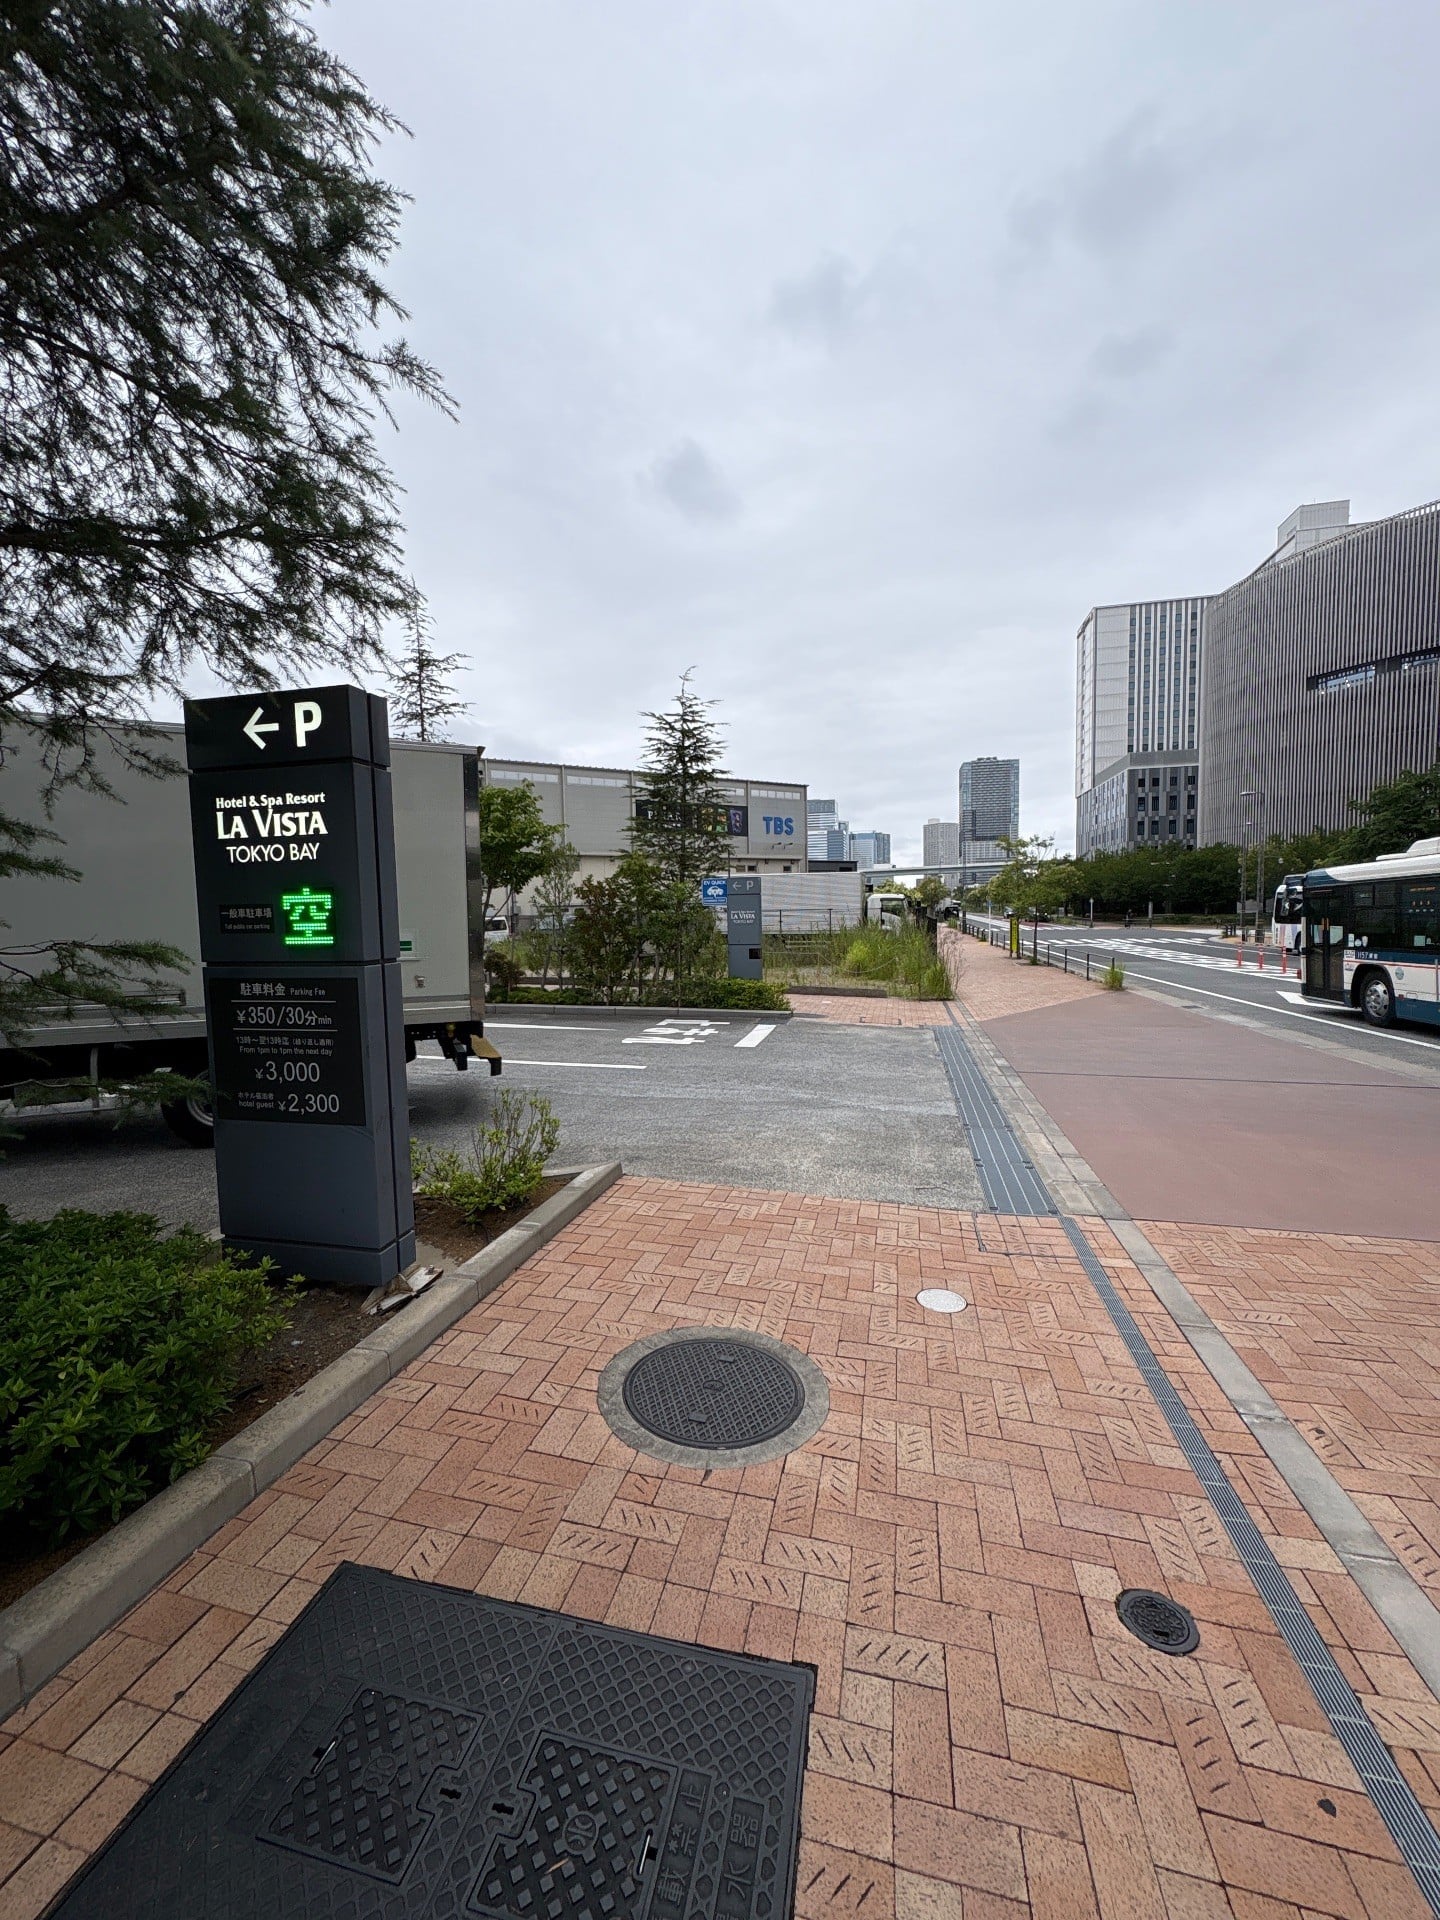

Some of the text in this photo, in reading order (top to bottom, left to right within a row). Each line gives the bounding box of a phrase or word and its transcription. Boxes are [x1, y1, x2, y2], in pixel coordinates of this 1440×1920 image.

[293, 701, 322, 748] P
[216, 792, 326, 809] Hotel & Spa Resort
[216, 808, 328, 840] LA VISTA
[763, 815, 794, 836] TBS
[226, 842, 320, 864] TOKYO BAY
[746, 880, 754, 891] P
[282, 887, 334, 945] 空
[240, 982, 326, 997] 駐車料金 Parking Fee
[621, 1018, 731, 1045] 止まれ
[239, 1046, 255, 1054] From
[280, 1048, 293, 1056] 1pm
[320, 1048, 333, 1057] day
[254, 1060, 320, 1084] ¥3,000
[238, 1100, 274, 1110] hotel guest
[278, 1093, 340, 1115] ¥2,300
[651, 1784, 708, 1920] 載禁止
[714, 1813, 760, 1920] 水器
